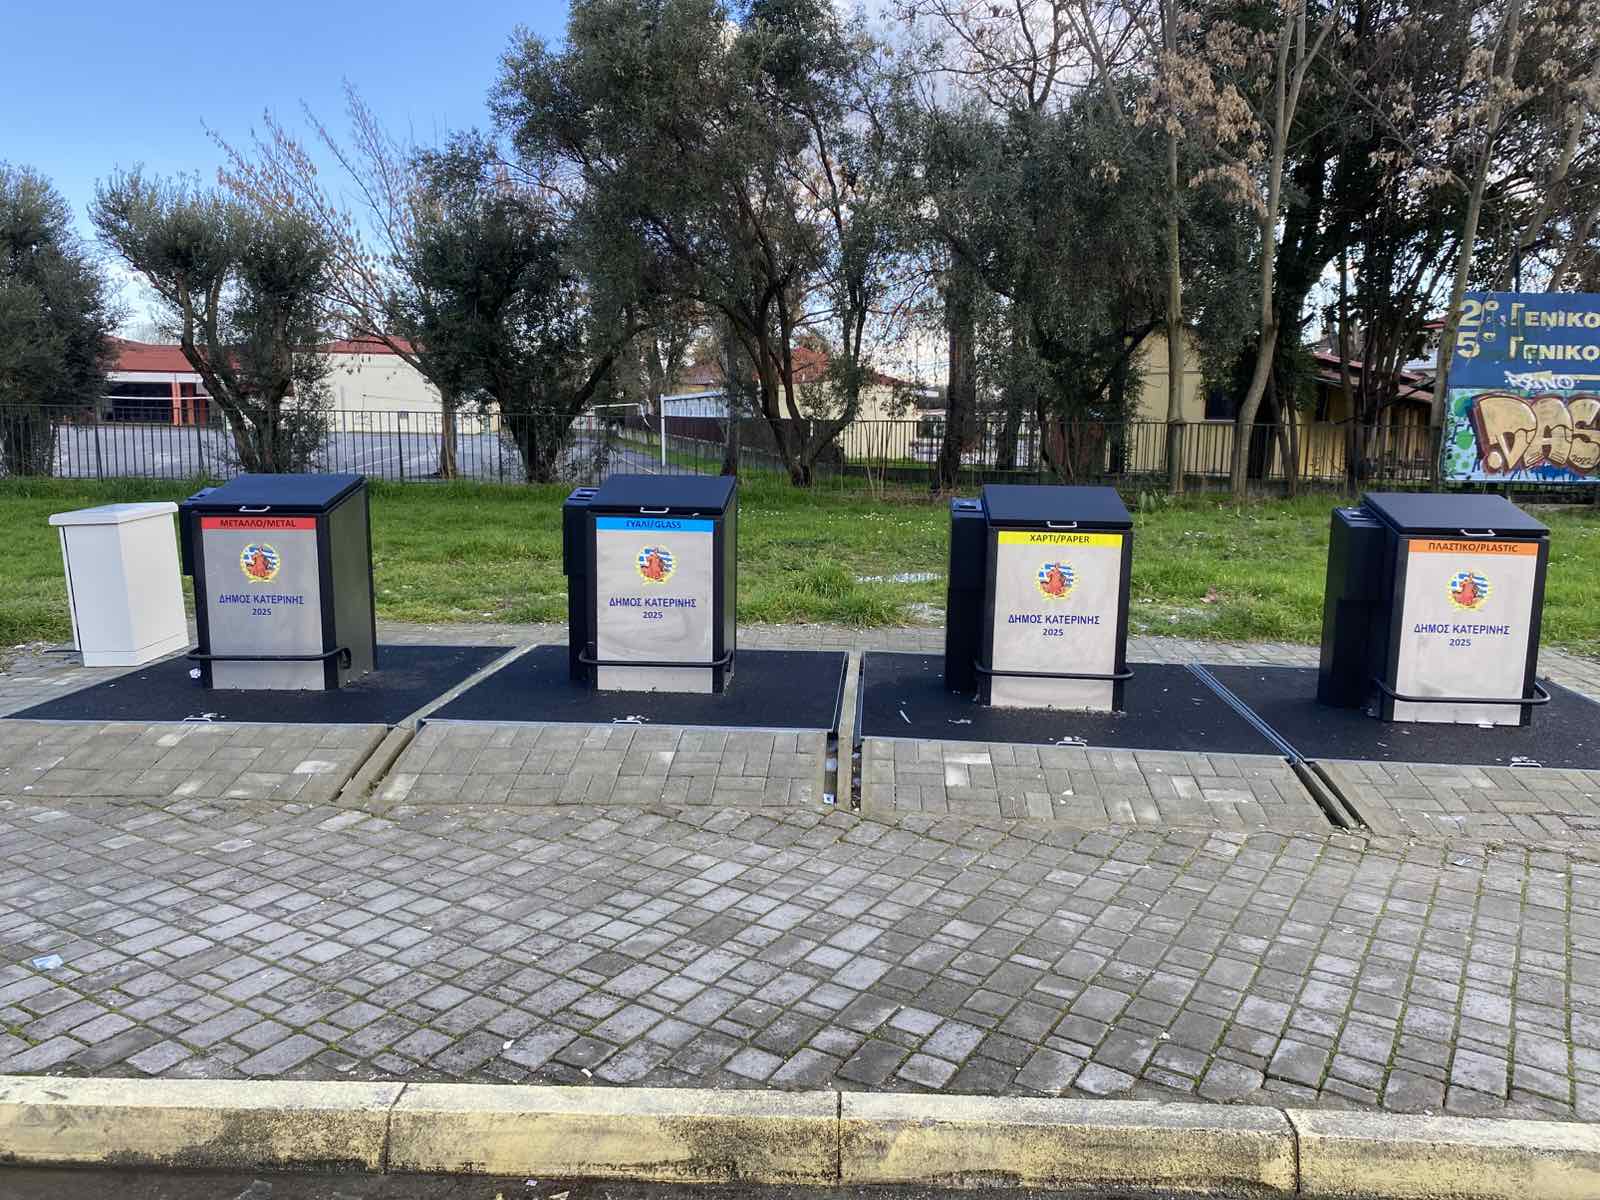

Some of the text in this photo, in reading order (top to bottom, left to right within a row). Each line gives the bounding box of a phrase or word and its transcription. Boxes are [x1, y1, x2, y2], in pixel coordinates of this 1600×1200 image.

[220, 519, 298, 529] ΜΕΤΑΛΛΟ/METAL
[1030, 534, 1090, 544] ΧΑΡΤΙ/PAPER
[1428, 542, 1519, 553] ΠΛΑΣΤΙΚΟ/PLASTIC
[219, 594, 305, 605] ΔΗΜΟΣ ΚΑΤΕΡΙΝΗΣ
[609, 597, 697, 608] ΔΗΜΟΣ ΚΑΤΕΡΙΝΗΣ
[252, 608, 272, 616] 2025
[643, 611, 663, 619] 2025
[1008, 614, 1100, 625] ΔΗΜΟΣ ΚΑΤΕΡΙΝΗΣ
[1042, 628, 1064, 636] 2025
[1414, 623, 1510, 635] ΔΗΜΟΣ ΚΑΤΕΡΙΝΗΣ
[1449, 638, 1472, 647] 2025
